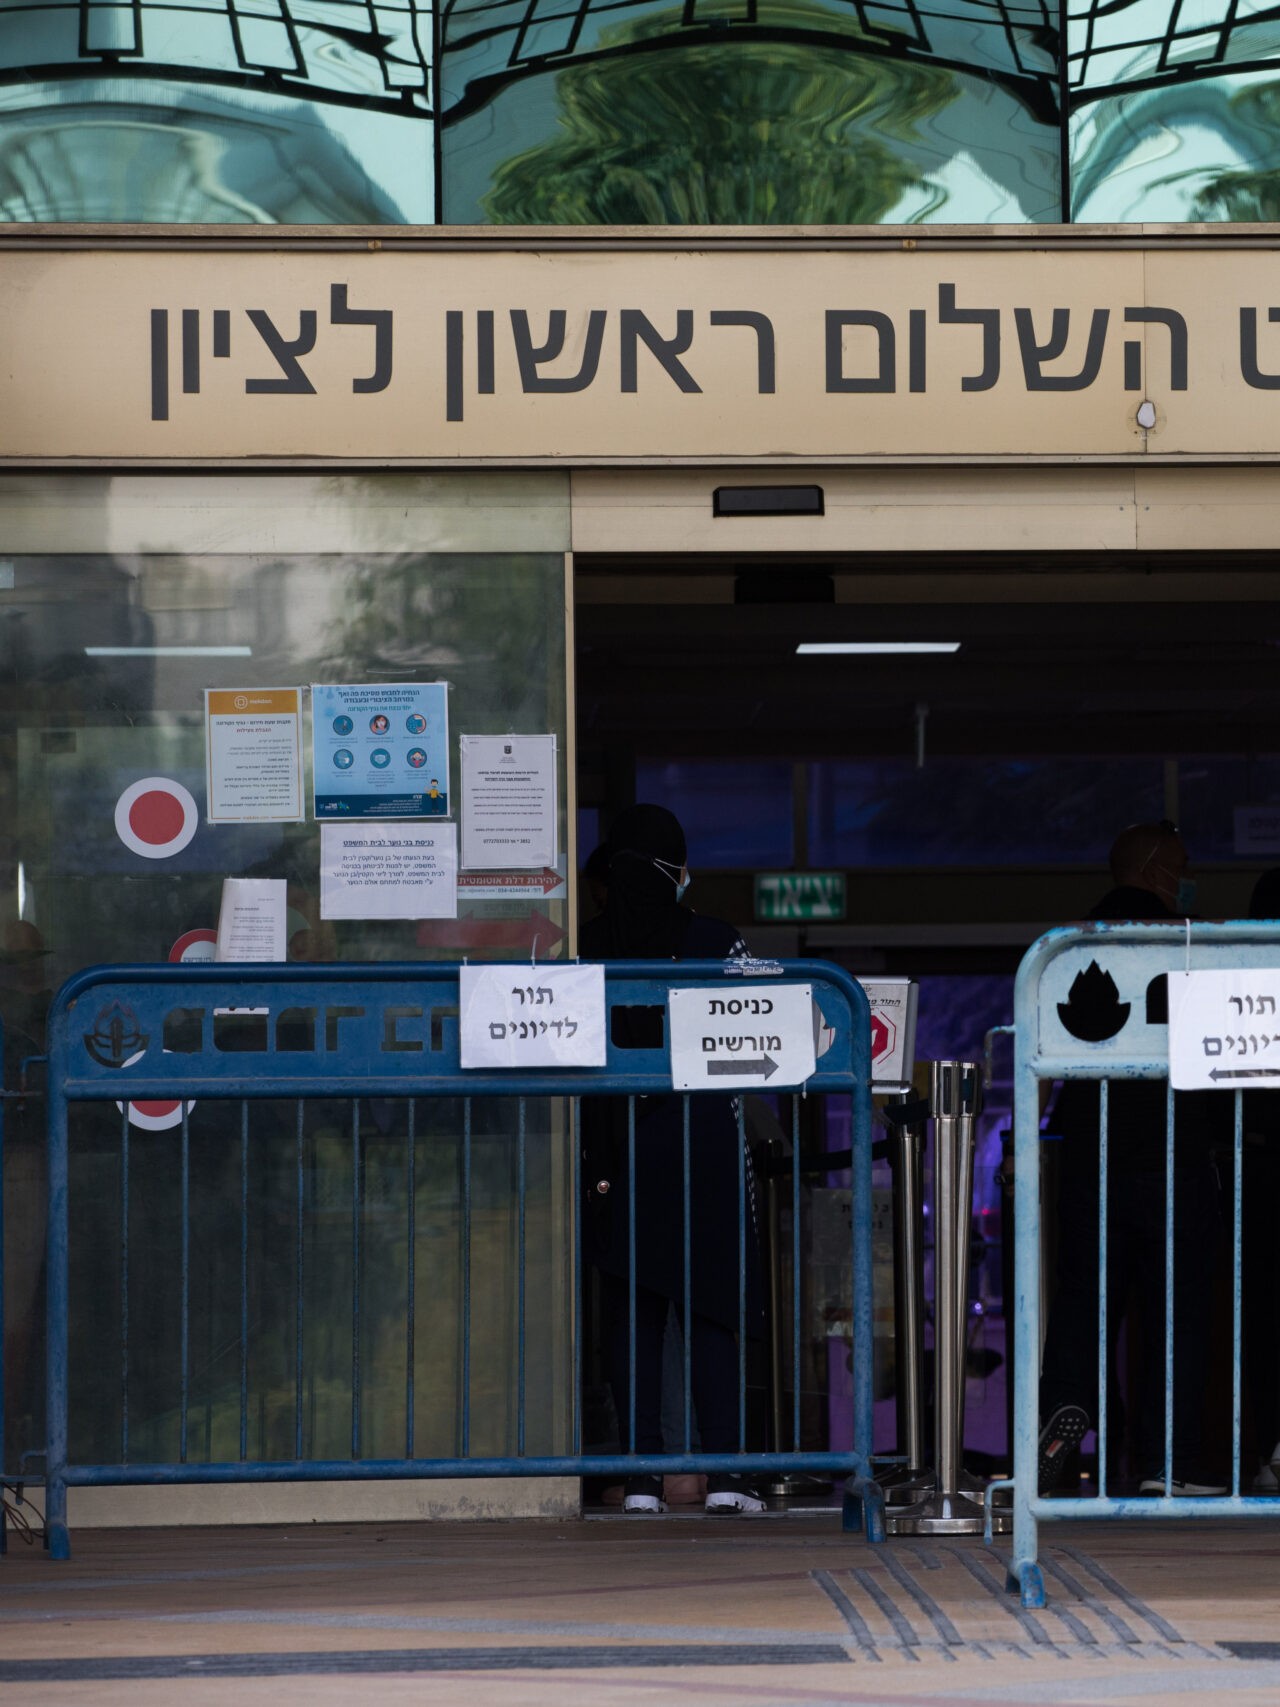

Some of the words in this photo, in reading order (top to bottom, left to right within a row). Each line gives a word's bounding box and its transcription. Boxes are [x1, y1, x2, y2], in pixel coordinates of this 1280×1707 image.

[825, 283, 1188, 393] השלום
[151, 283, 393, 421] לציון
[446, 309, 775, 422] ראשון
[459, 877, 502, 885] אוטומטית
[506, 875, 524, 885] דלת
[527, 877, 557, 885] זהירות
[760, 878, 841, 916] יציאה
[511, 986, 555, 1006] תור
[1228, 995, 1277, 1016] תור
[709, 998, 774, 1017] כניסת
[487, 1016, 578, 1041] לדיונים
[701, 1033, 783, 1055] מורשים
